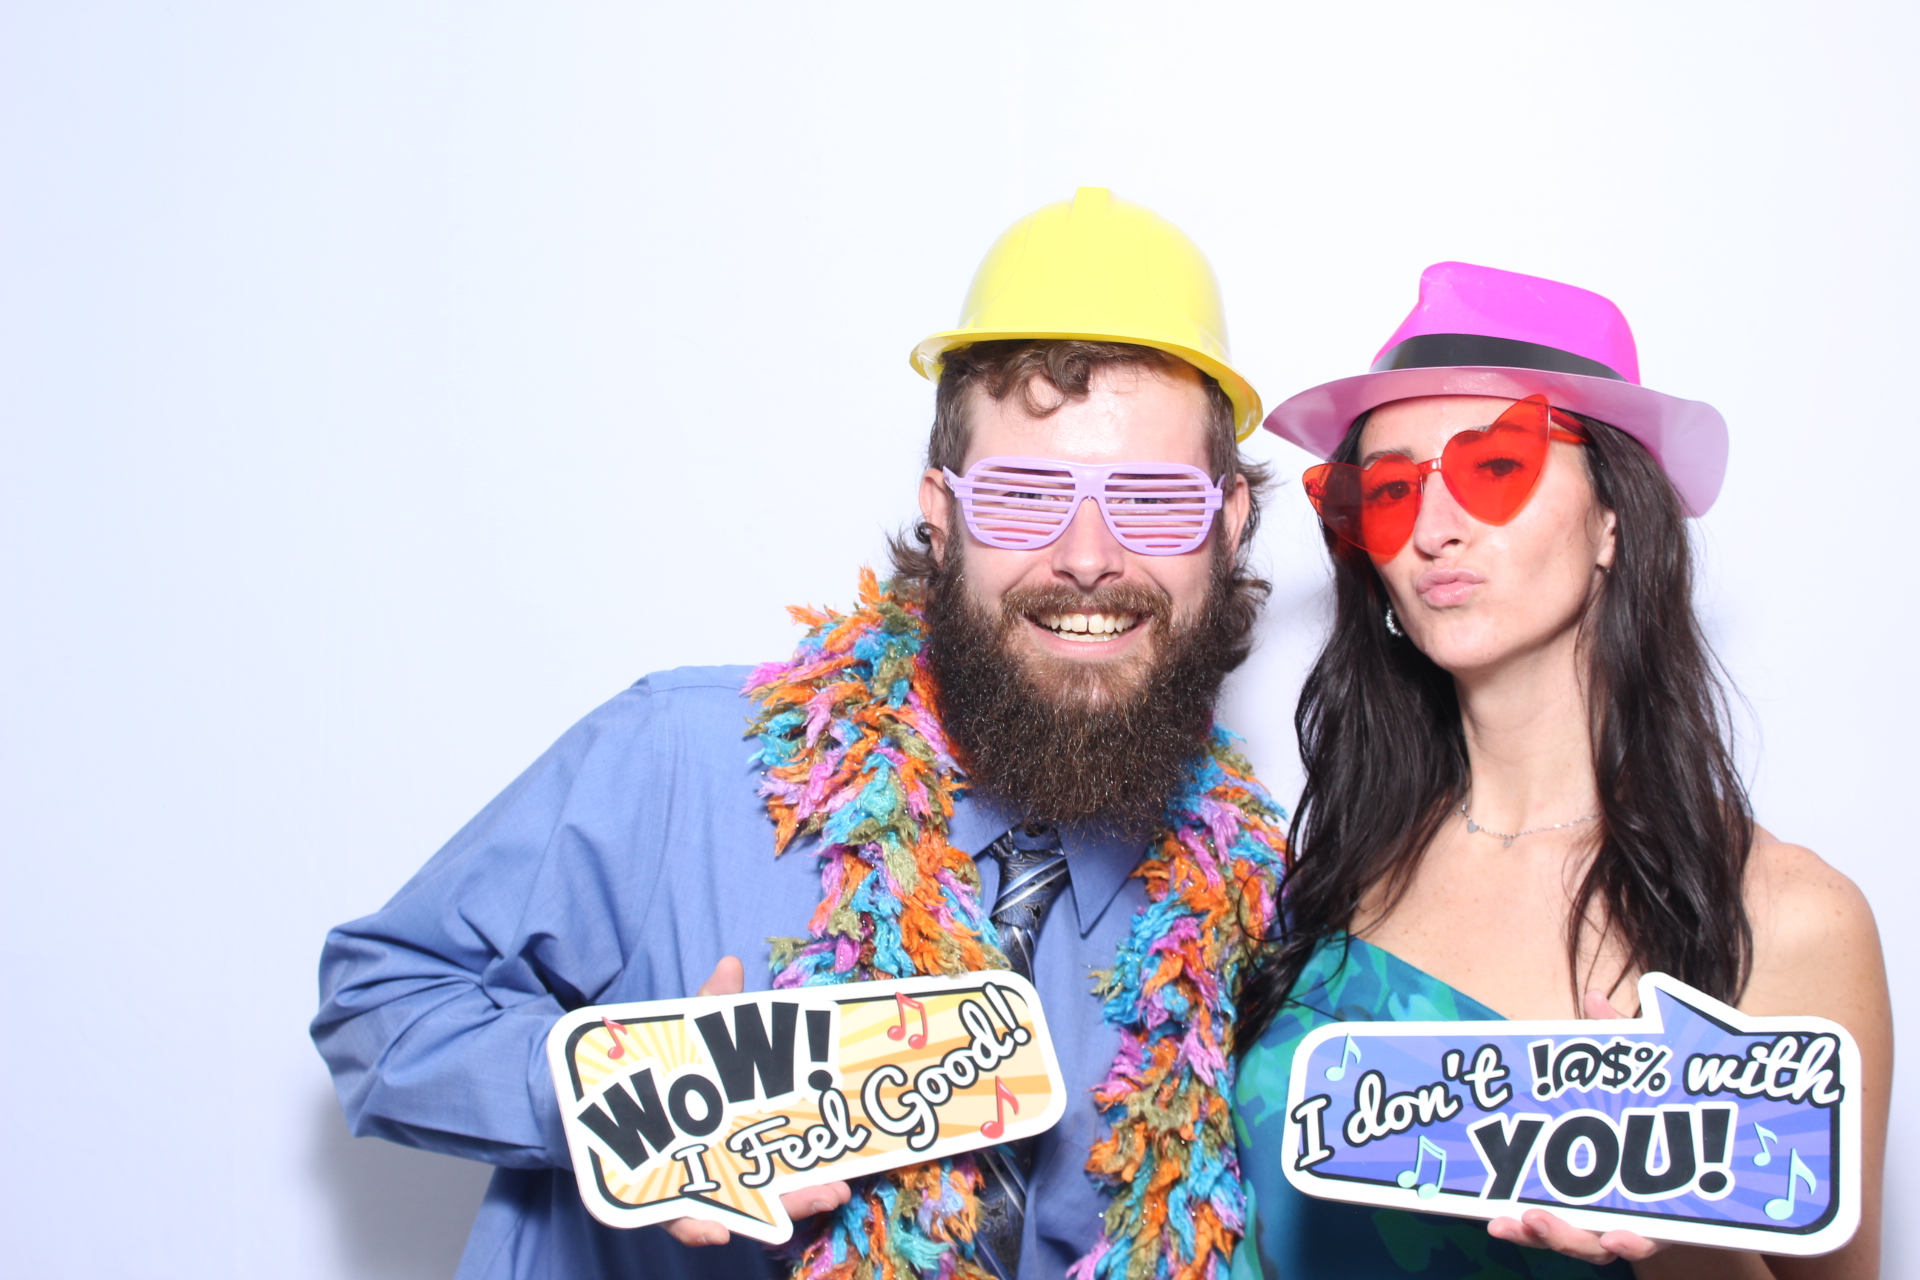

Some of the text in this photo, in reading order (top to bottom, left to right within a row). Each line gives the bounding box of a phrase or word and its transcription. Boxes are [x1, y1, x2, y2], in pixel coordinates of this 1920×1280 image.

[671, 982, 1032, 1195] I Feel Good!
[1293, 1097, 1334, 1170] I
[1341, 1043, 1513, 1147] don't
[1684, 1031, 1846, 1106] with
[1473, 1107, 1732, 1201] YOU!
